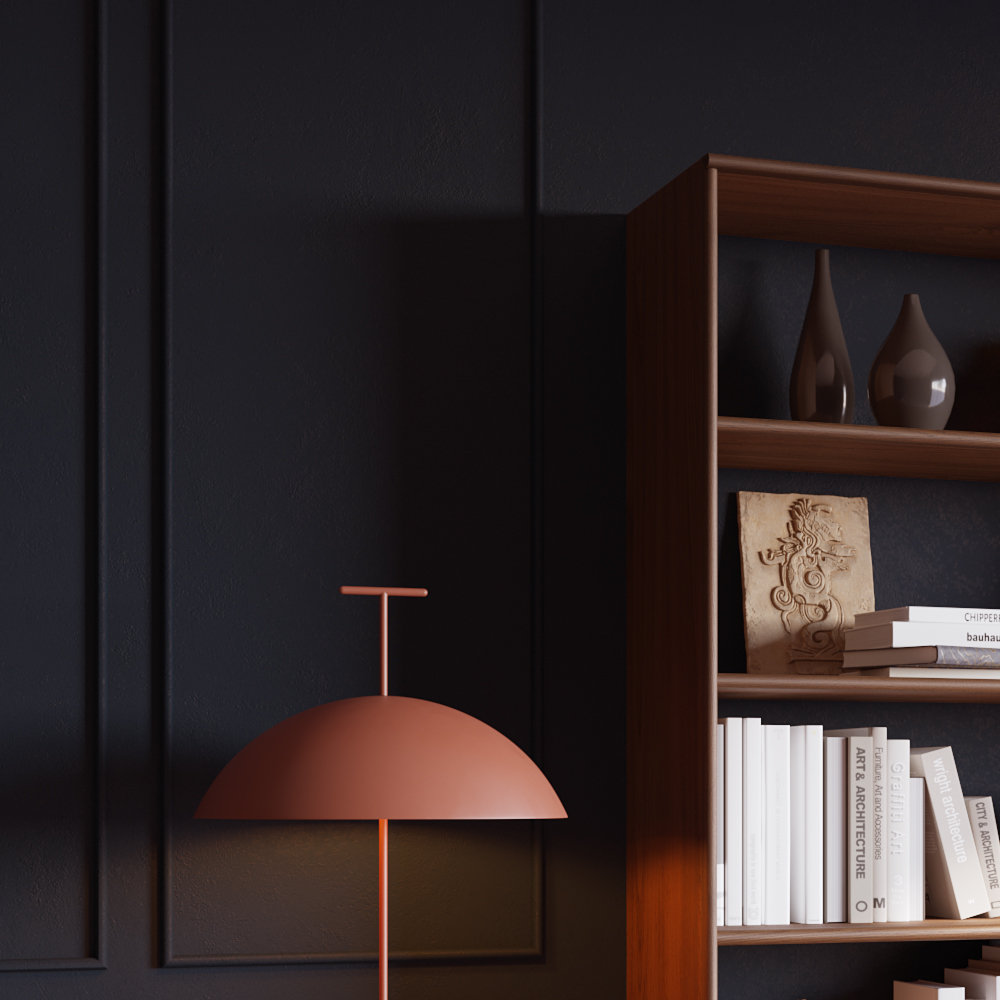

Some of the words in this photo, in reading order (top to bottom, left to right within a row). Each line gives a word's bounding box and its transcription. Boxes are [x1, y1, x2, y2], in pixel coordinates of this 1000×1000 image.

[856, 747, 866, 770] ART
[874, 747, 884, 784] Furniture,
[856, 772, 866, 781] &
[874, 784, 883, 796] Art
[890, 761, 905, 824] Graffiti
[874, 798, 883, 813] and
[932, 758, 952, 794] wright
[942, 796, 969, 864] architecture
[975, 802, 988, 820] CITY
[856, 786, 866, 880] ARCHITECTURE
[874, 814, 883, 860] Accessories
[890, 830, 905, 856] Art
[980, 830, 1000, 890] ARCHITECTURE
[873, 898, 886, 909] M
